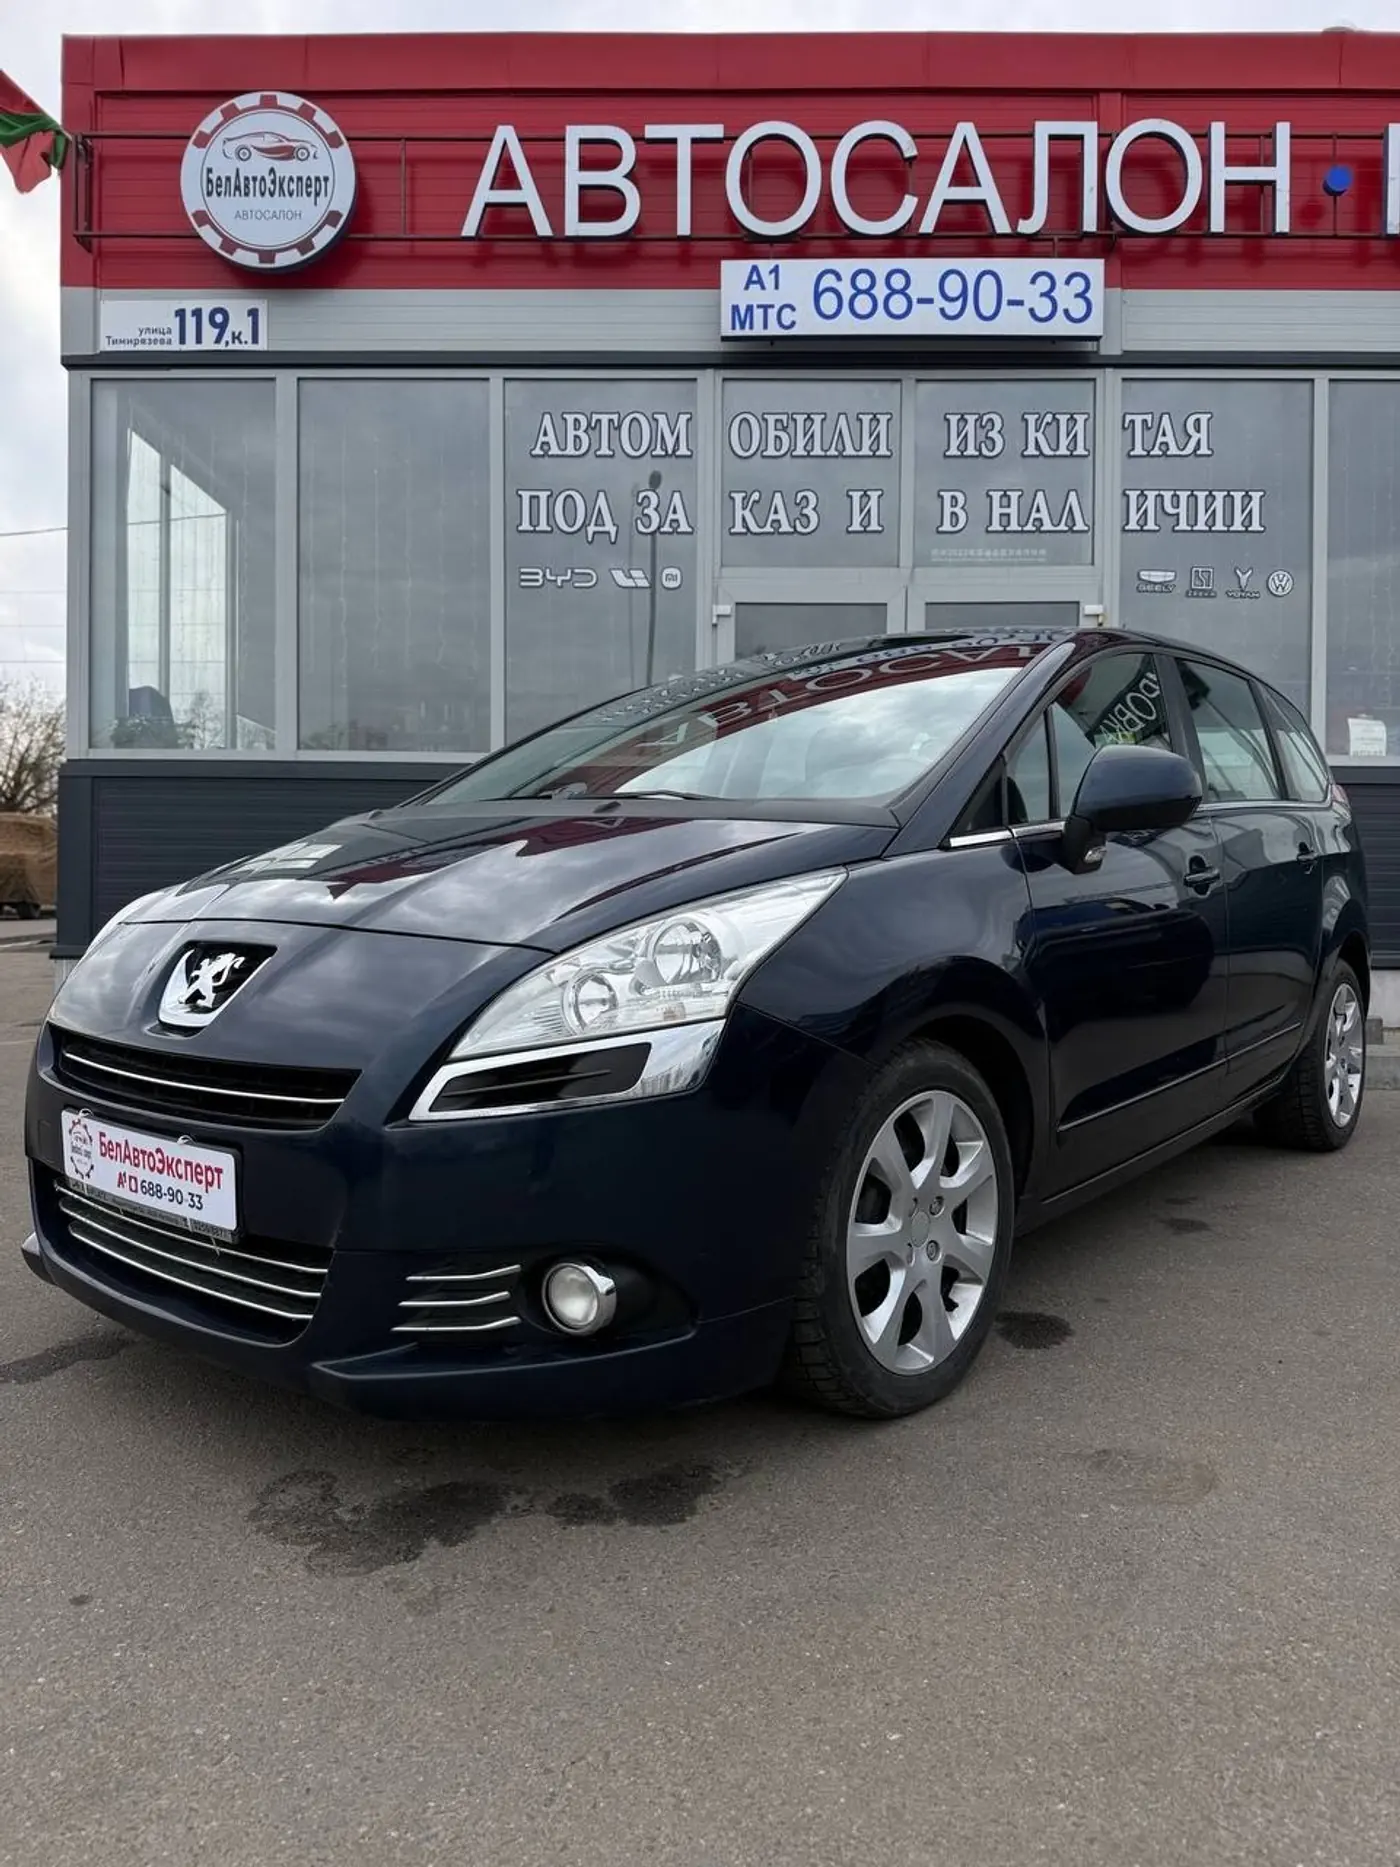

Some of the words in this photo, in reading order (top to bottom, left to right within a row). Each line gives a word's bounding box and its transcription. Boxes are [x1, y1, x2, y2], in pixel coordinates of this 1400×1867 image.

[205, 166, 330, 207] БелАвтоЭксперт
[461, 117, 1290, 238] АВТОСАЛОН
[234, 209, 302, 221] АВТОСАЛОН
[811, 267, 1094, 324] 688-90-33
[138, 326, 173, 336] улица
[729, 303, 798, 332] МТС
[105, 335, 173, 347] Тимирязева
[943, 411, 1006, 459] ИЗ
[515, 489, 619, 544] ПОД
[846, 489, 885, 534] И
[935, 489, 969, 534] В
[518, 567, 598, 589] BYD
[98, 1131, 224, 1193] БелАвтоЭксперт
